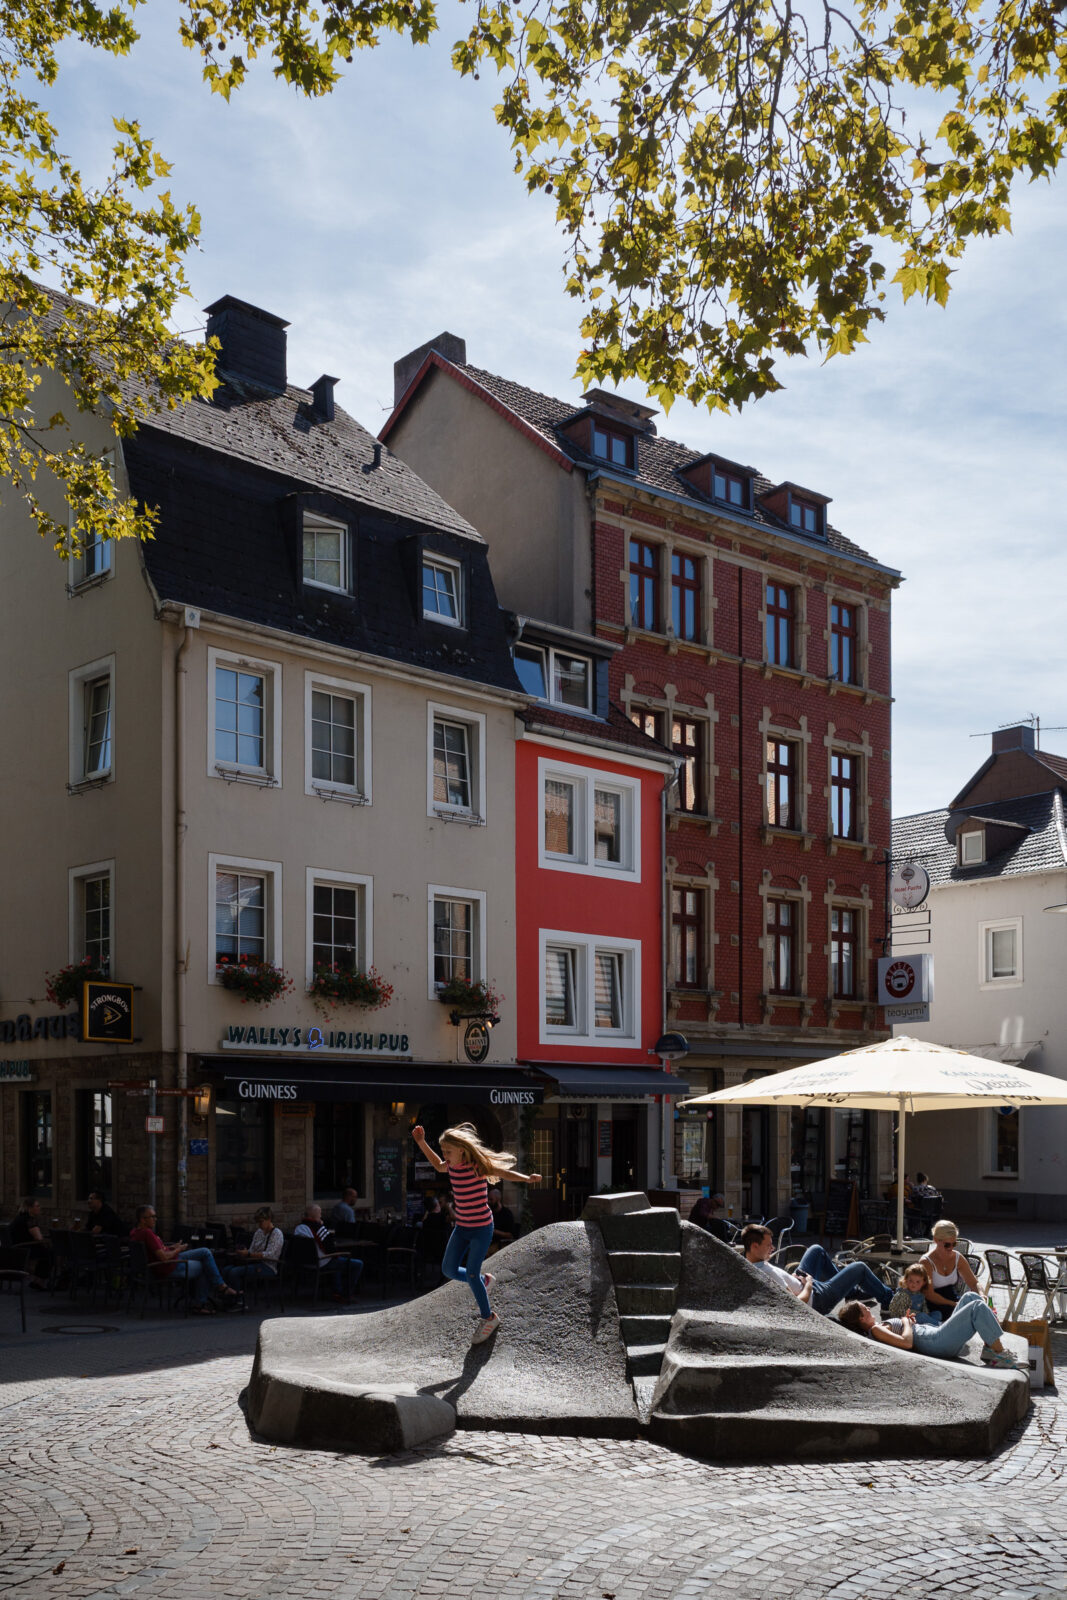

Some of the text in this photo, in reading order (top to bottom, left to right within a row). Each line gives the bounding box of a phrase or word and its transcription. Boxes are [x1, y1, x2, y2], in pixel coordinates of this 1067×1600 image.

[90, 994, 130, 1013] STRONGBOW
[228, 1026, 409, 1051] WALLY'S IRISH PUB
[9, 1061, 29, 1077] PUB
[239, 1080, 297, 1099] GUINNESS
[490, 1089, 535, 1104] GUINNESS
